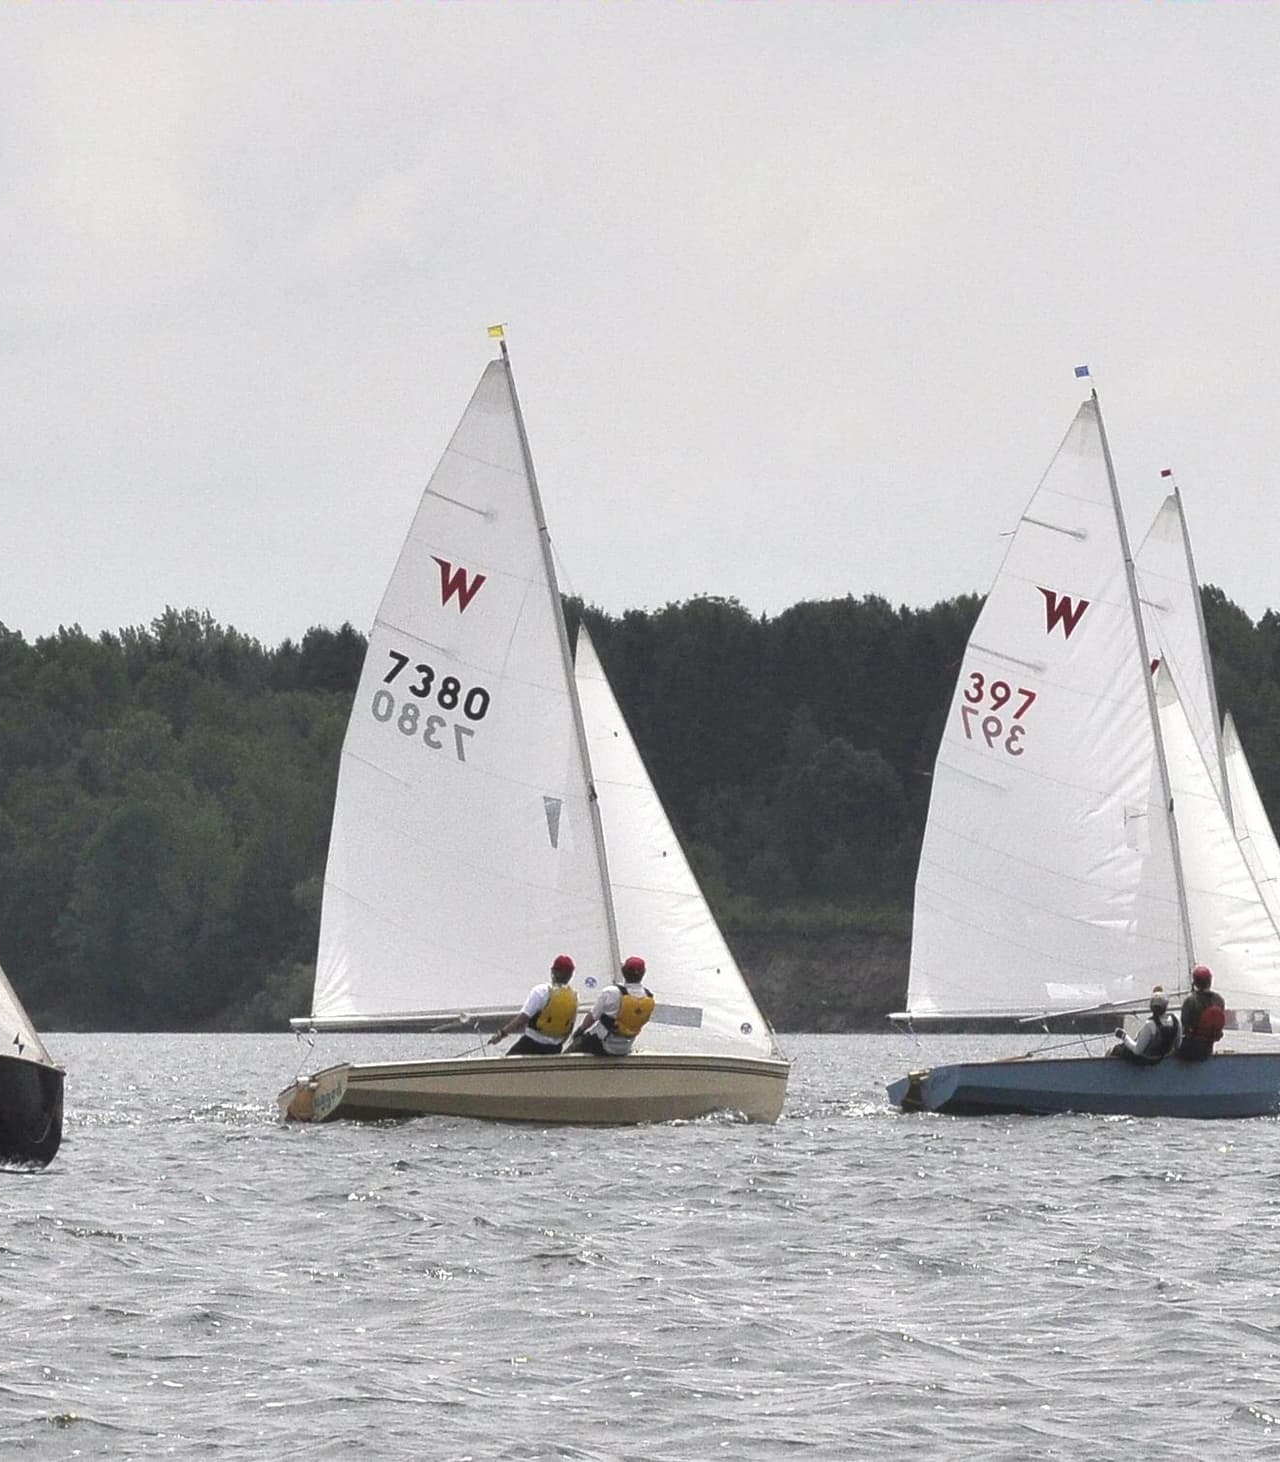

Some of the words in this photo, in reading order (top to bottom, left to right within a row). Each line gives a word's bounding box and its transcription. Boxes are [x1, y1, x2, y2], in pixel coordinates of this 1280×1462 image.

[430, 555, 487, 614] W
[1036, 586, 1090, 639] W
[383, 650, 490, 721] 7380
[964, 672, 1037, 720] 397
